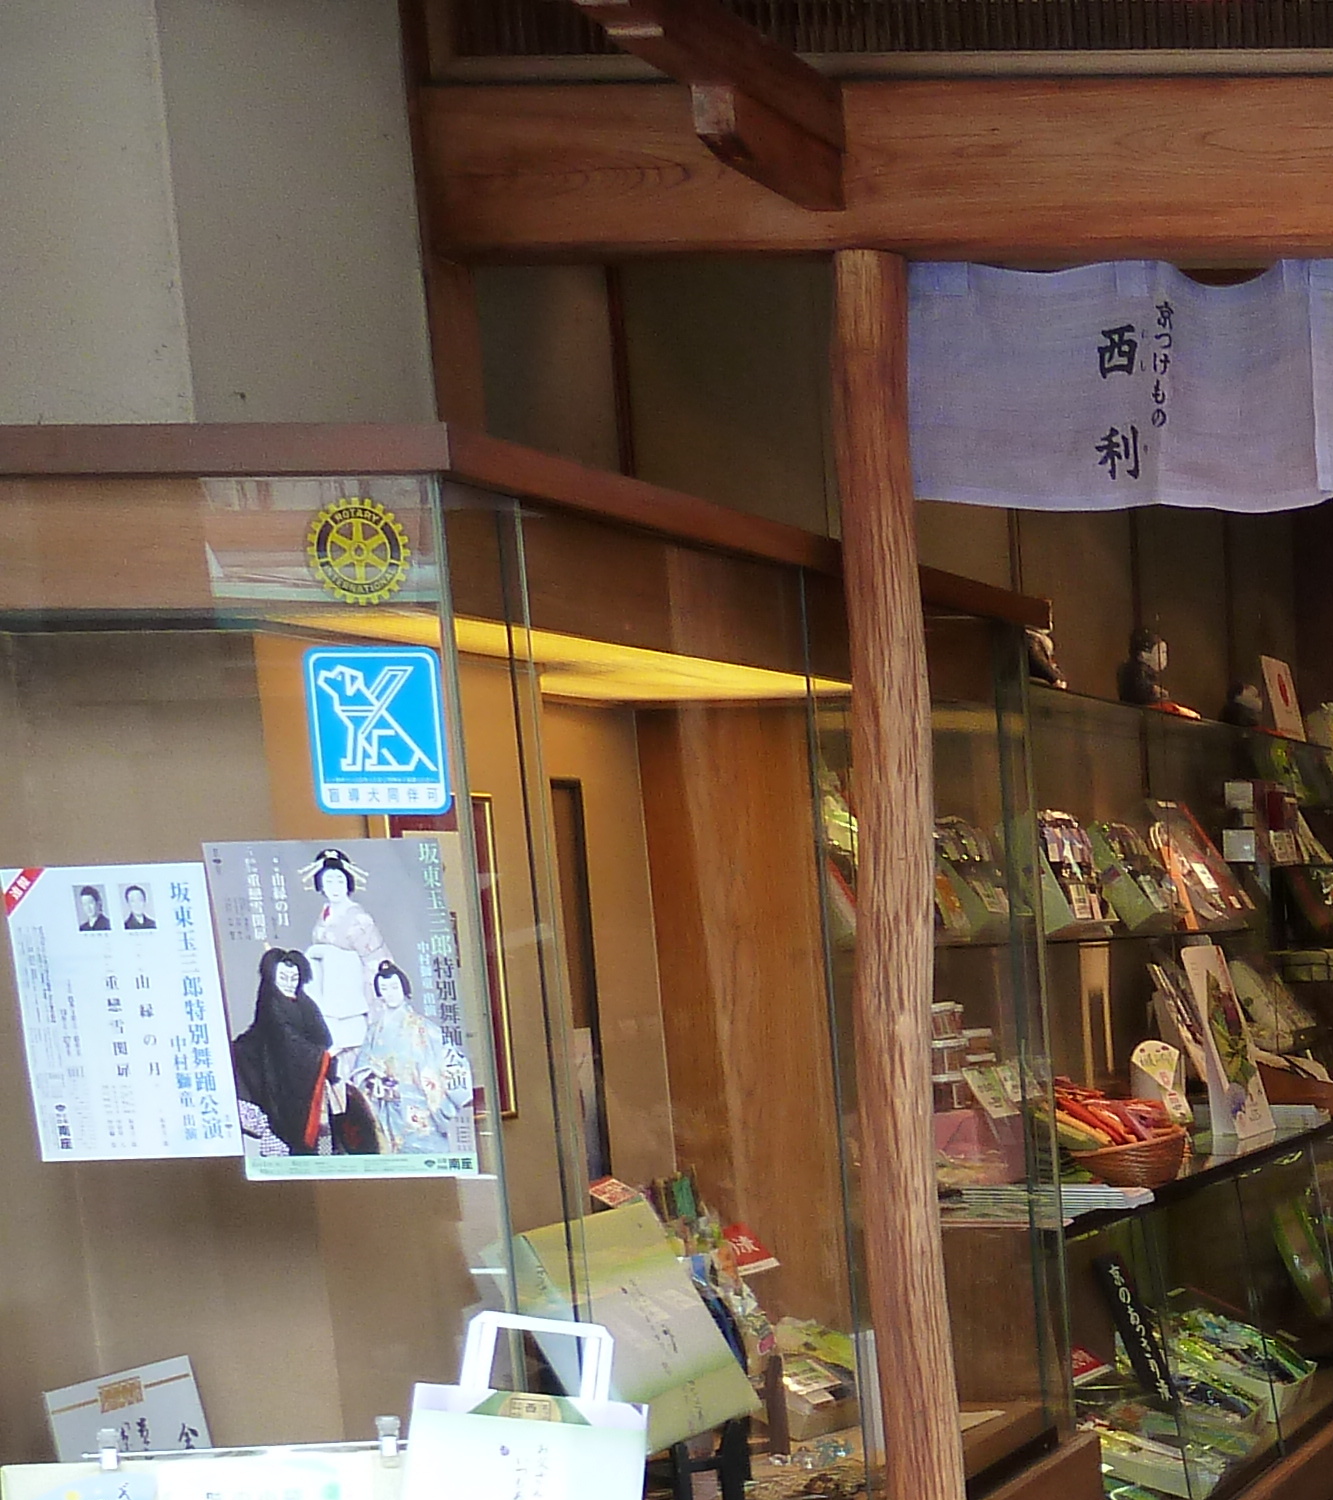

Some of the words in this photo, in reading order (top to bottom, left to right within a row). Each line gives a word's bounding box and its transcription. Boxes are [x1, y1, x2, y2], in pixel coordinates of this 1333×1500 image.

[1096, 324, 1141, 482] 西利
[1153, 300, 1175, 428] 京つけもの
[334, 507, 380, 524] ROTARY
[170, 880, 225, 1141] 坂東玉三郎特別舞踊公演
[418, 842, 467, 1091] 坂東玉三郎特別舞踊公演
[1108, 1263, 1173, 1402] 京のあっさり漬
